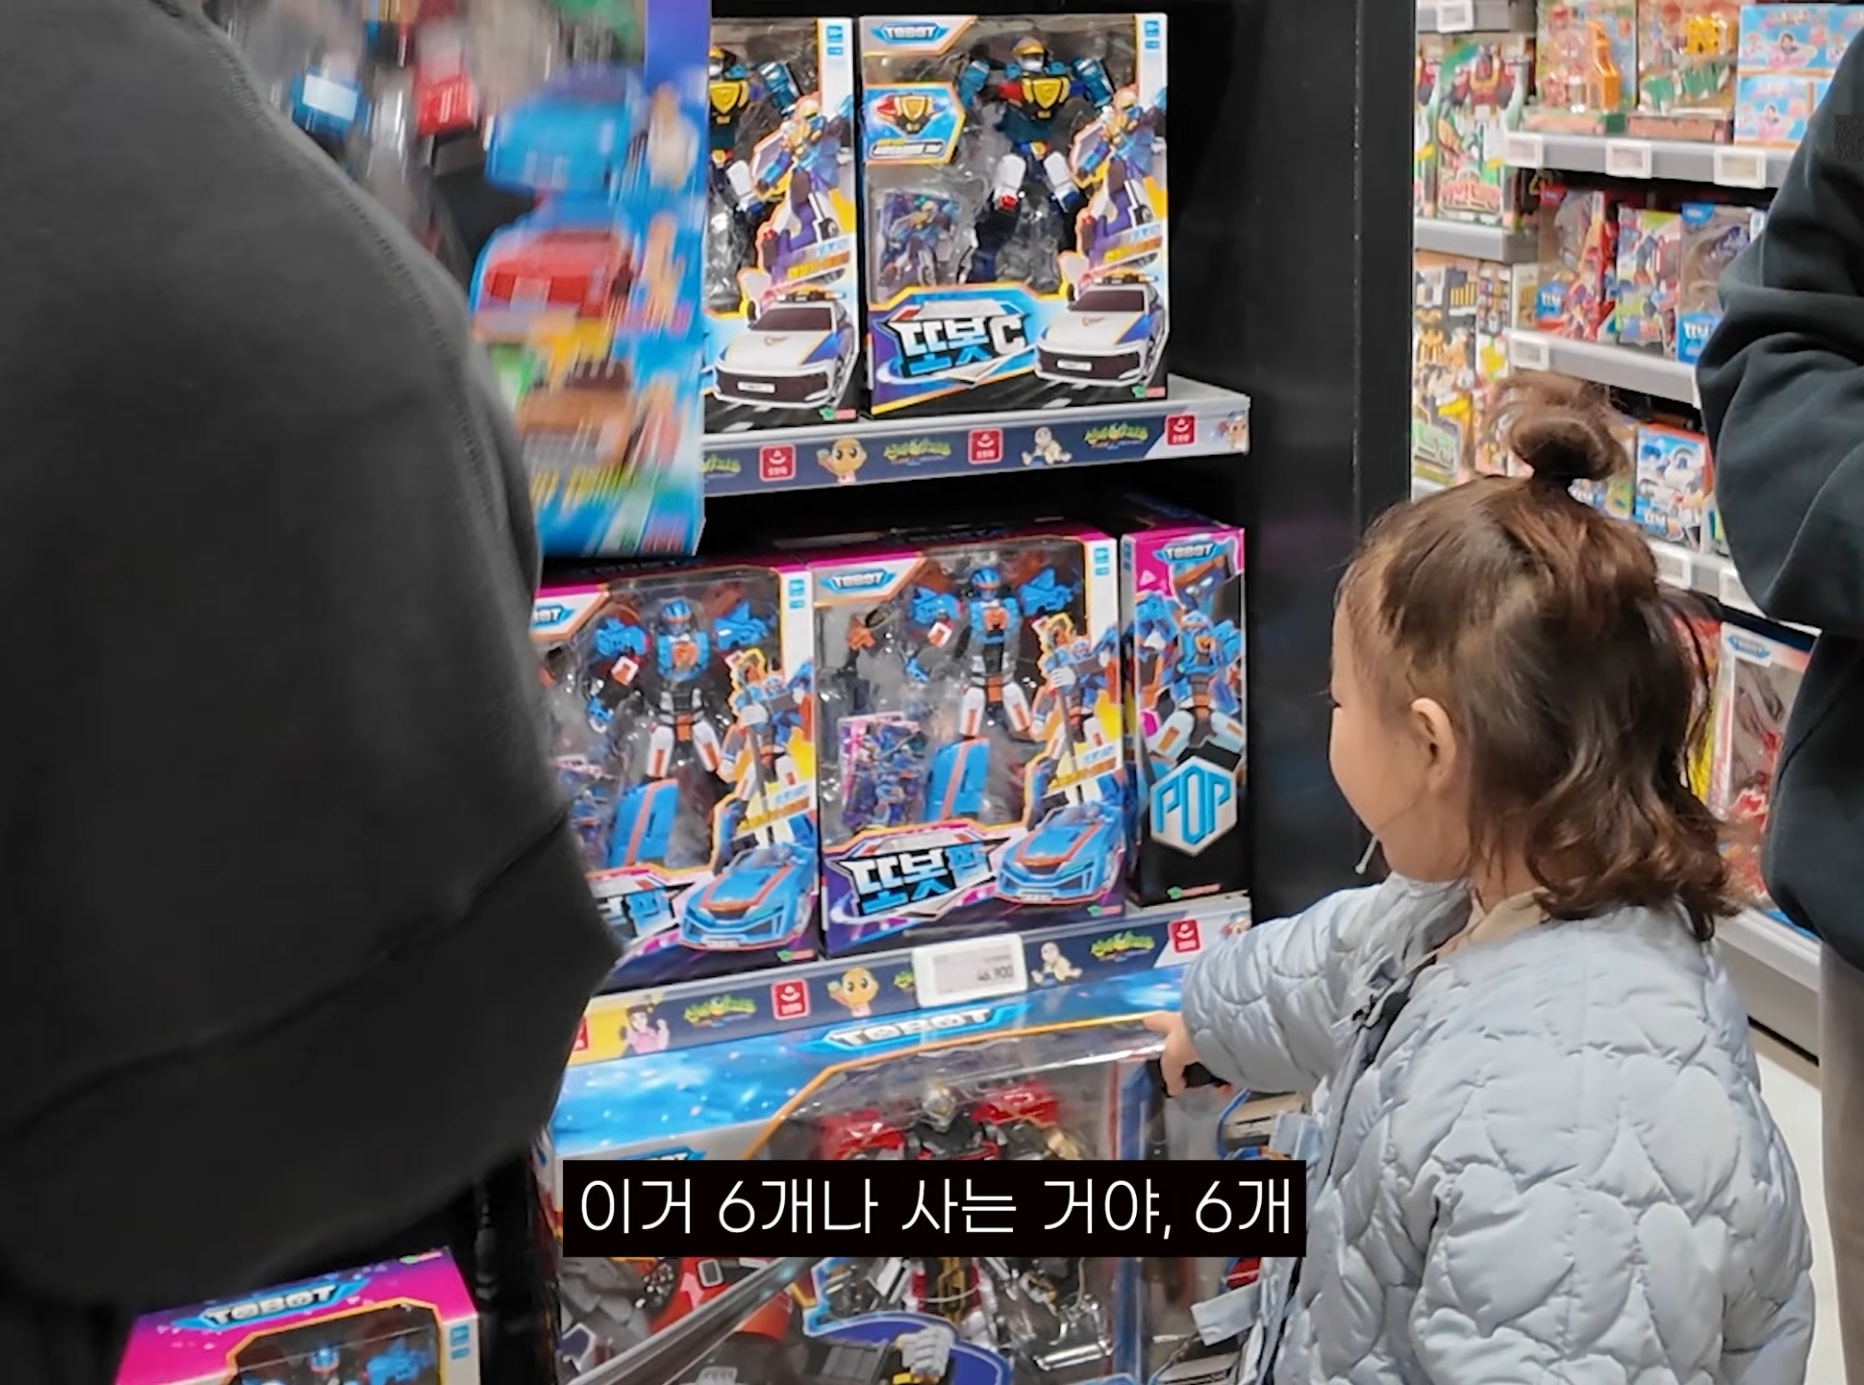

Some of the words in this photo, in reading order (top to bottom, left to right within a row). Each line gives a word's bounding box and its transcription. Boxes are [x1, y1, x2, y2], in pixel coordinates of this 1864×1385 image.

[1155, 764, 1231, 845] POP
[828, 1007, 991, 1046] TOBOT
[204, 1284, 337, 1324] TOBOT
